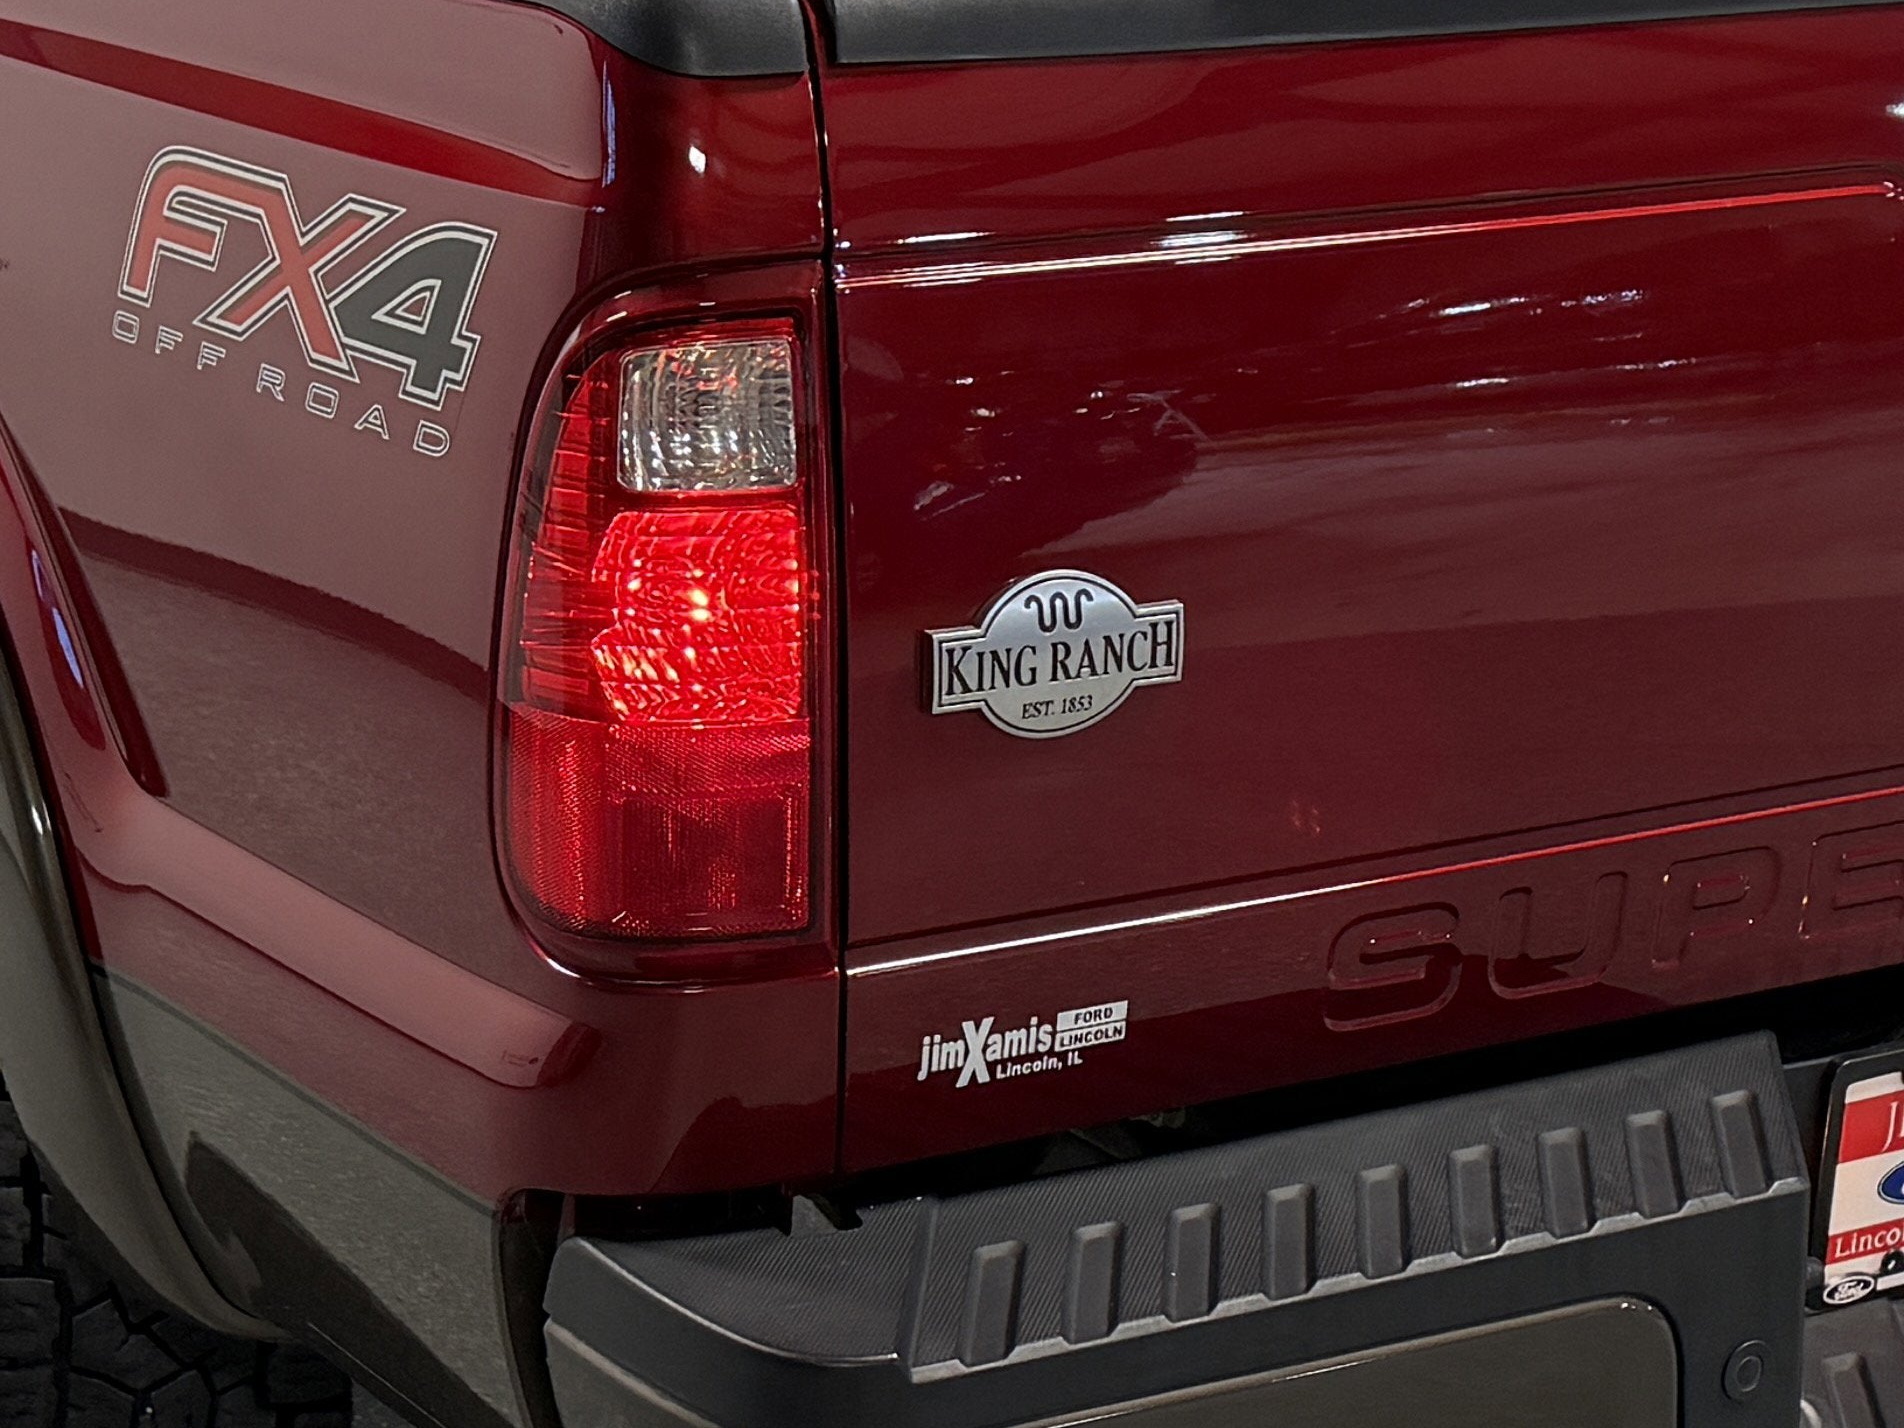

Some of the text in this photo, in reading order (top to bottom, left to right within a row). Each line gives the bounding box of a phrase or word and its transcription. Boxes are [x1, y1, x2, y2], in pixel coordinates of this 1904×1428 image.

[116, 144, 498, 411] FX4
[111, 310, 451, 458] OFF ROAD
[944, 620, 1174, 696] KING RANCH
[1020, 694, 1094, 721] EST. 1853
[1073, 1006, 1114, 1026] FORD
[1058, 1025, 1124, 1048] LINCOLN
[996, 1050, 1084, 1080] Lincoln, IL
